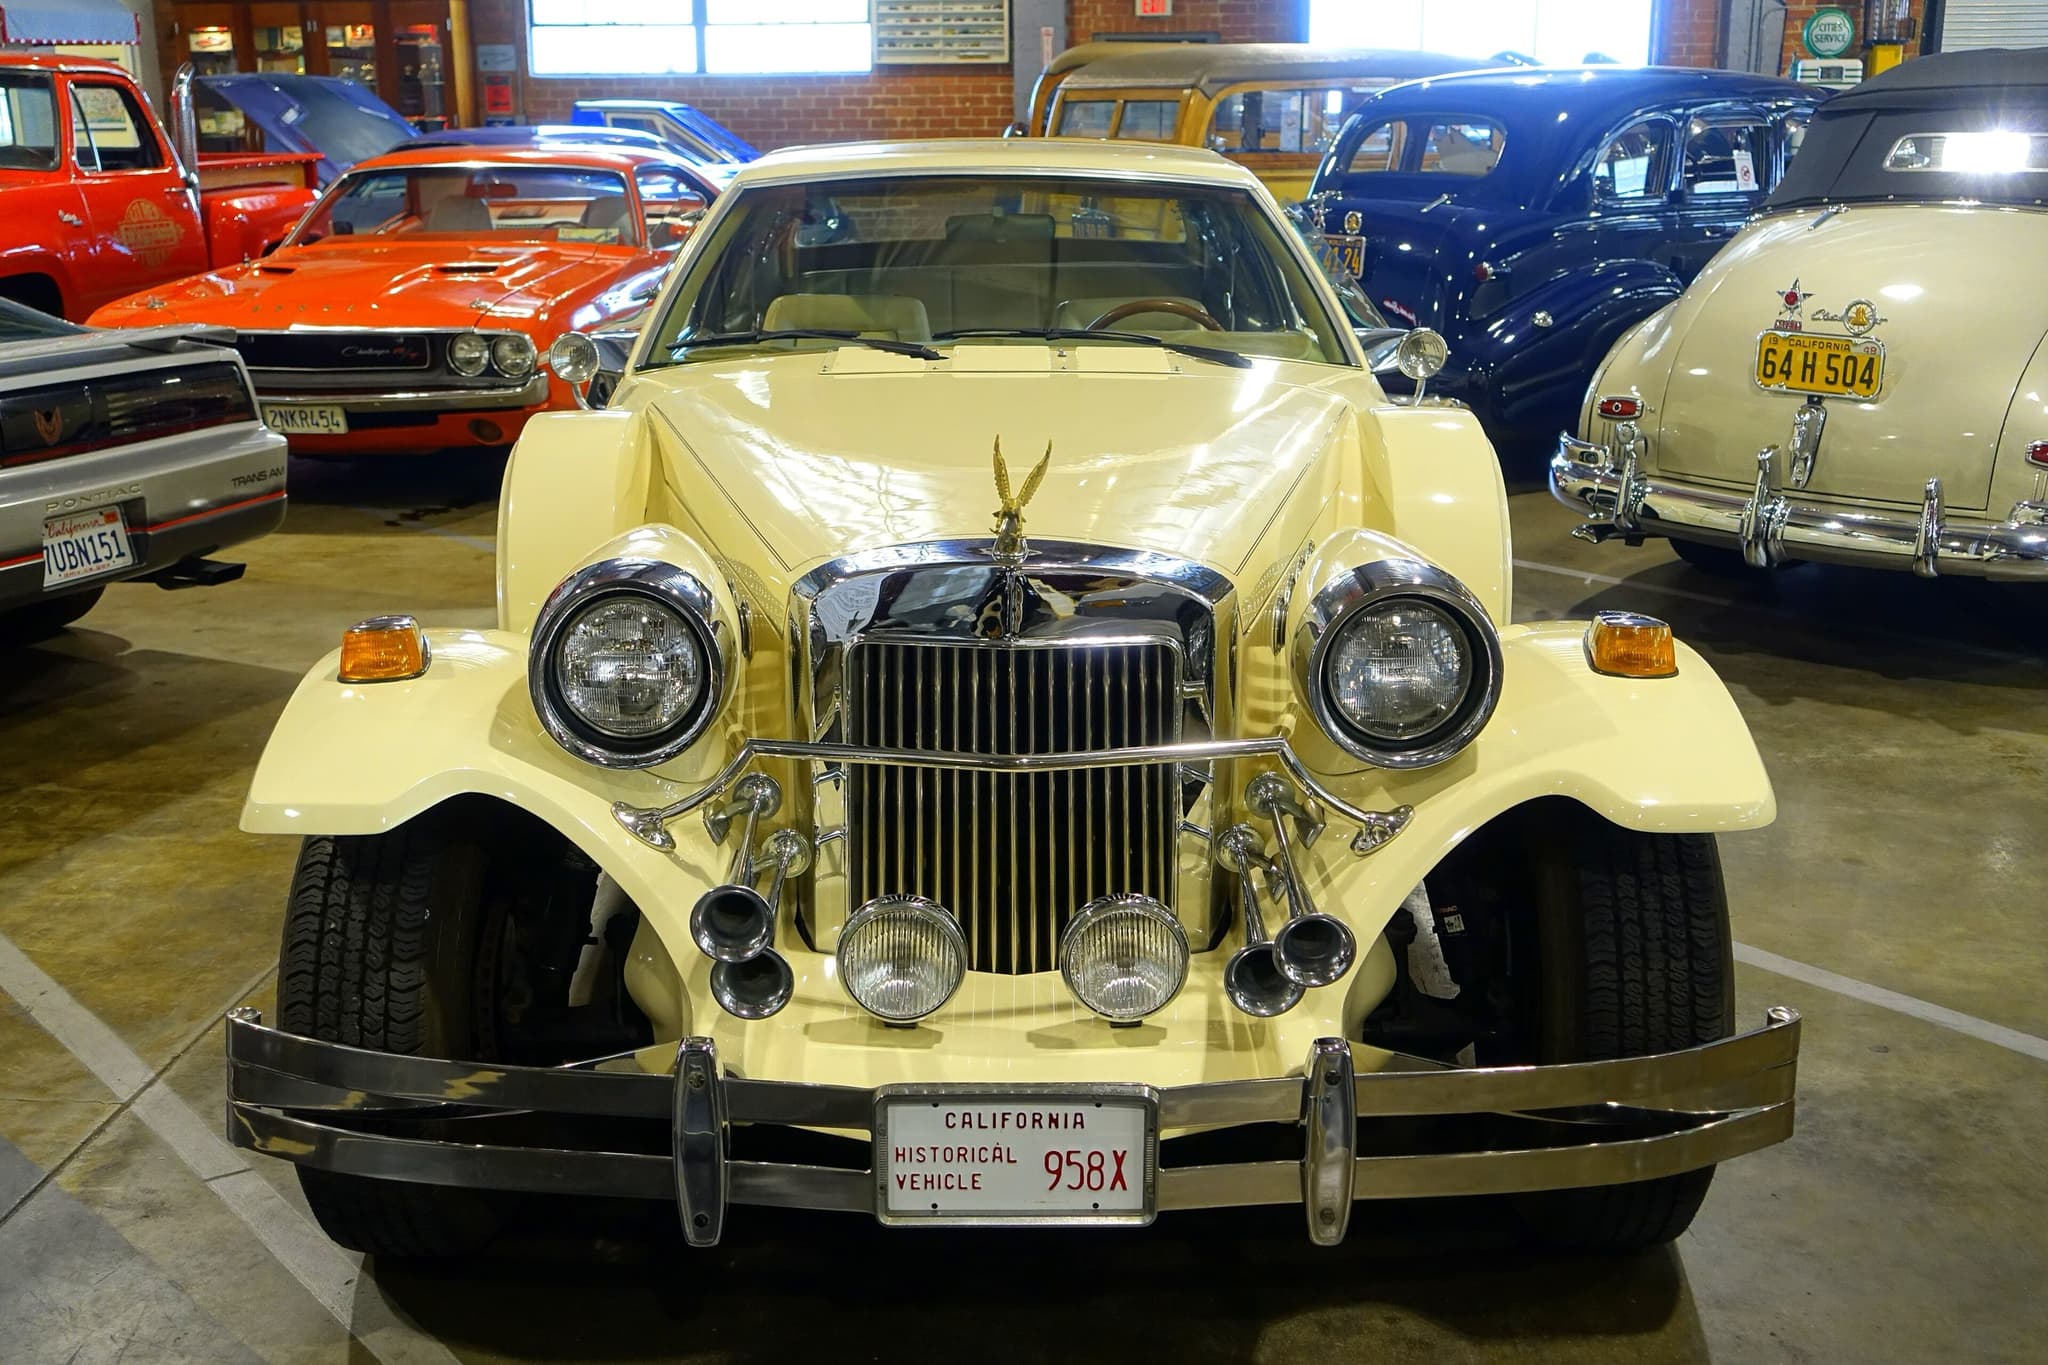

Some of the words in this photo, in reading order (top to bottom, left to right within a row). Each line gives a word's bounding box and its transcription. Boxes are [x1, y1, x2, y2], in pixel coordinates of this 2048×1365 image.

[1818, 23, 1843, 32] CITIES
[1814, 33, 1846, 43] SERVICE
[1769, 336, 1779, 345] 19
[1788, 338, 1850, 352] CALIFORNIA
[1762, 348, 1793, 381] 64
[1801, 351, 1817, 384] H
[1825, 353, 1875, 390] 504
[269, 409, 340, 428] 2NKR454
[231, 470, 268, 488] TRANS
[268, 466, 285, 479] AM
[45, 482, 142, 513] PONTIAC
[48, 519, 101, 538] California
[945, 1112, 1085, 1129] CALIFORNIA
[895, 1146, 1018, 1164] HISTORICAL
[1044, 1150, 1128, 1191] 958X
[896, 1173, 982, 1190] VEHICLE
